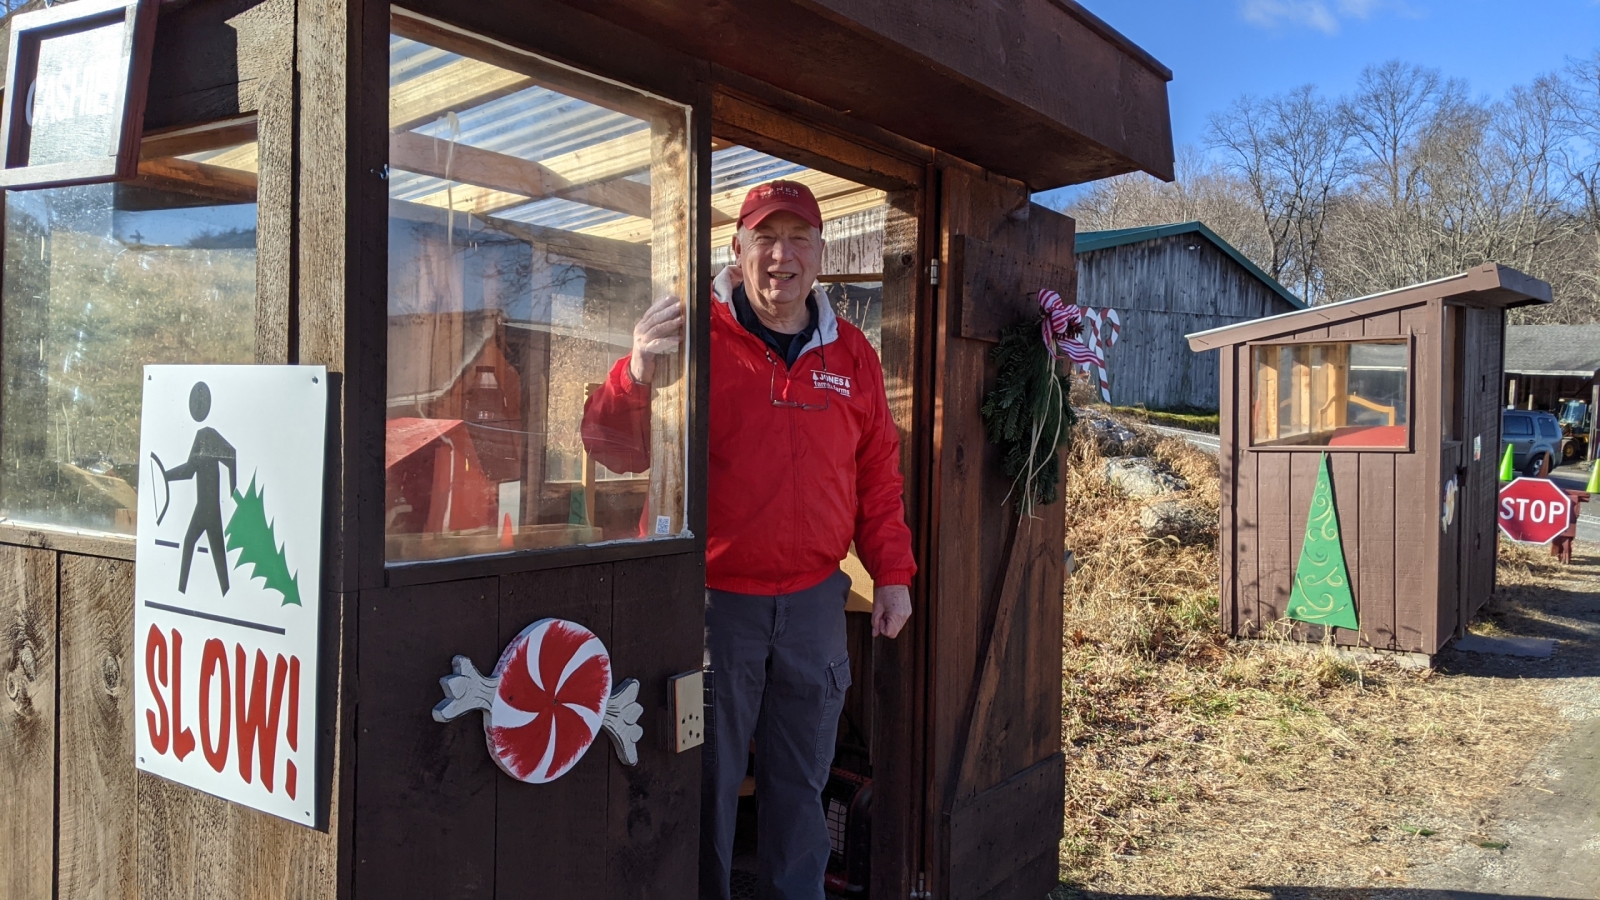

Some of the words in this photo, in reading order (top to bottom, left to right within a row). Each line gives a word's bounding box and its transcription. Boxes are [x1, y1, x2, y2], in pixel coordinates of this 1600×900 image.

[819, 373, 844, 385] JONES
[1500, 497, 1565, 524] STOP
[145, 623, 300, 801] SLOW!
